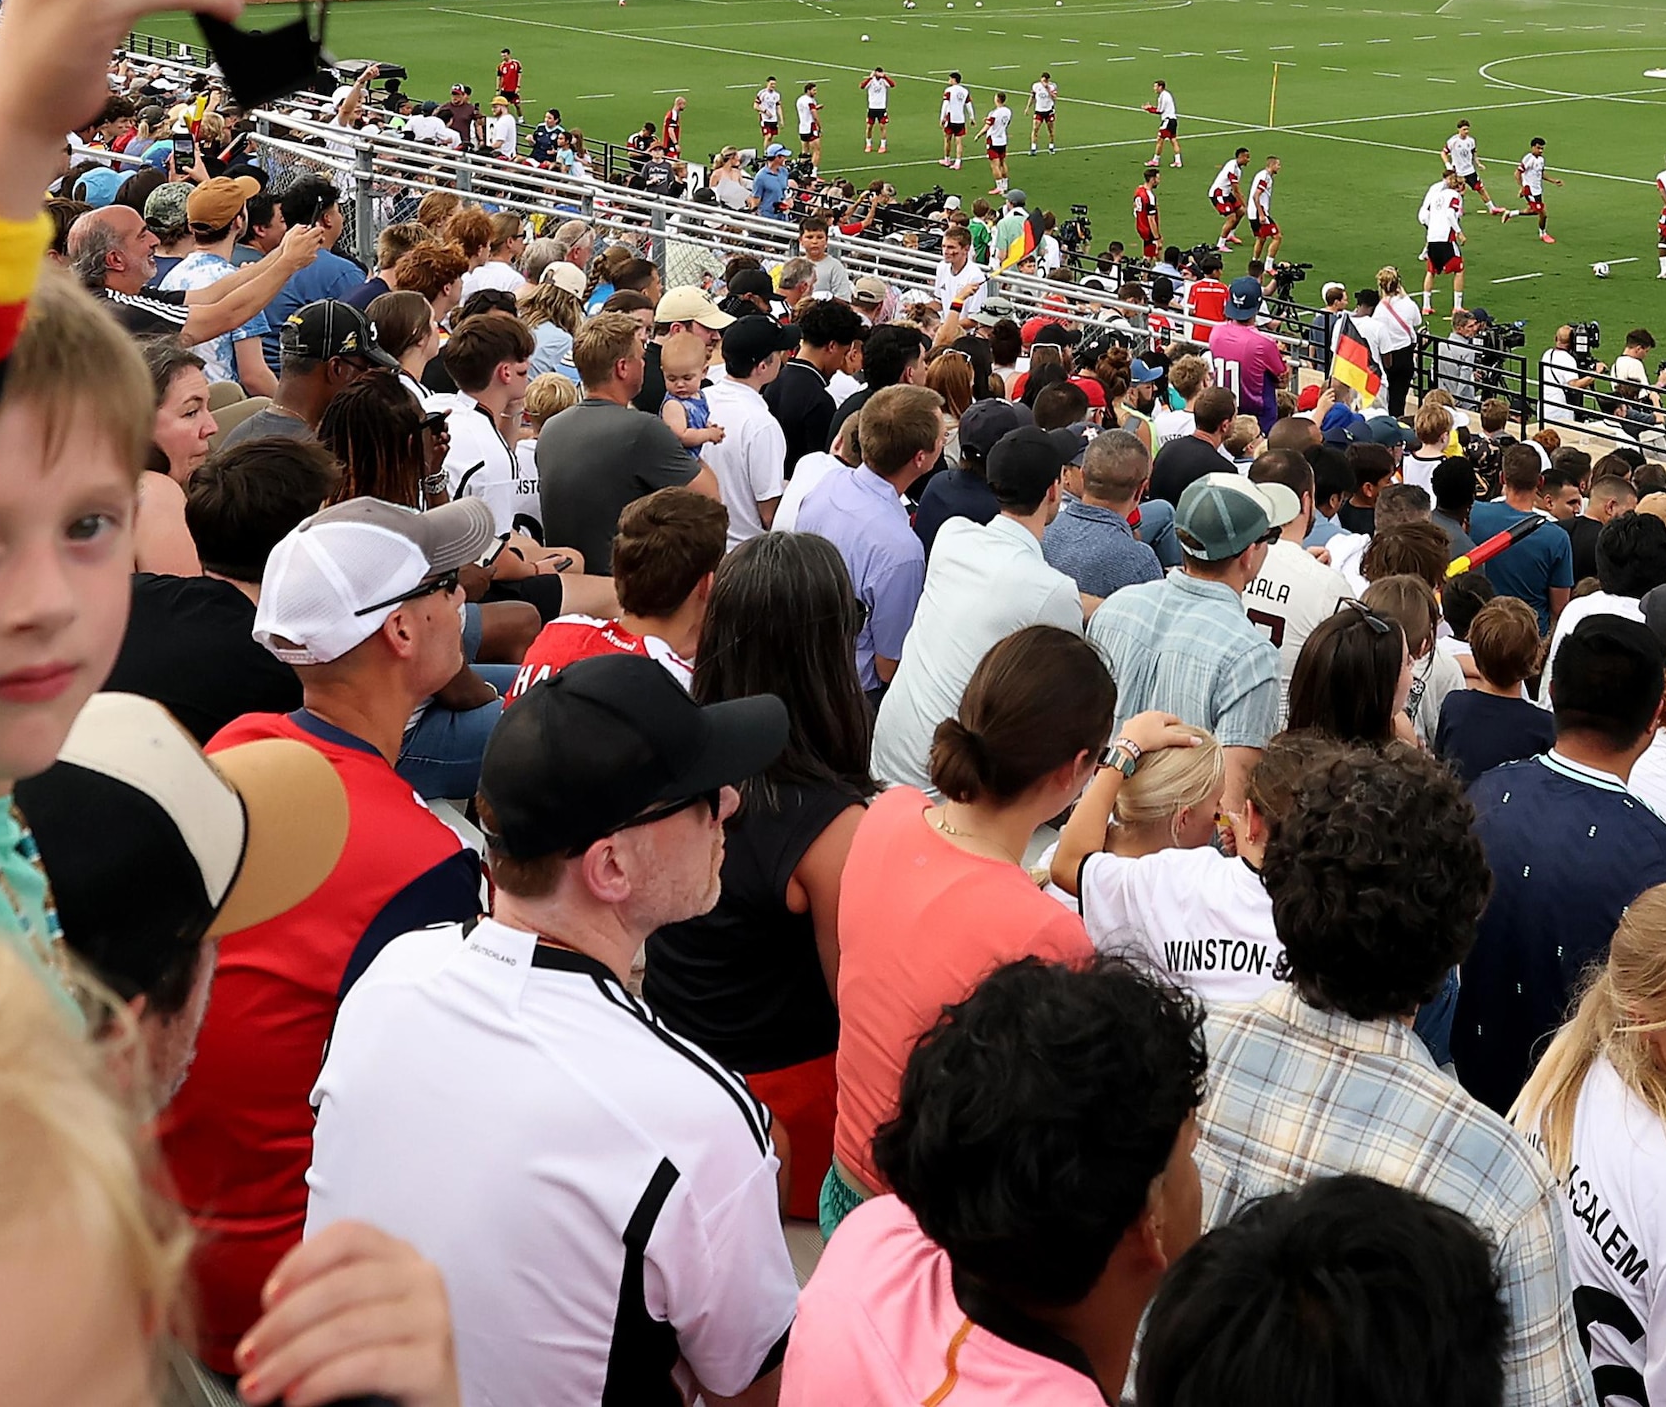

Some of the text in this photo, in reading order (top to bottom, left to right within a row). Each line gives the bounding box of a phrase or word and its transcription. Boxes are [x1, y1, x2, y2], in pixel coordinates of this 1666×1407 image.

[1214, 357, 1241, 408] 11
[1243, 577, 1291, 604] IALA
[1163, 938, 1290, 981] WINSTON-S
